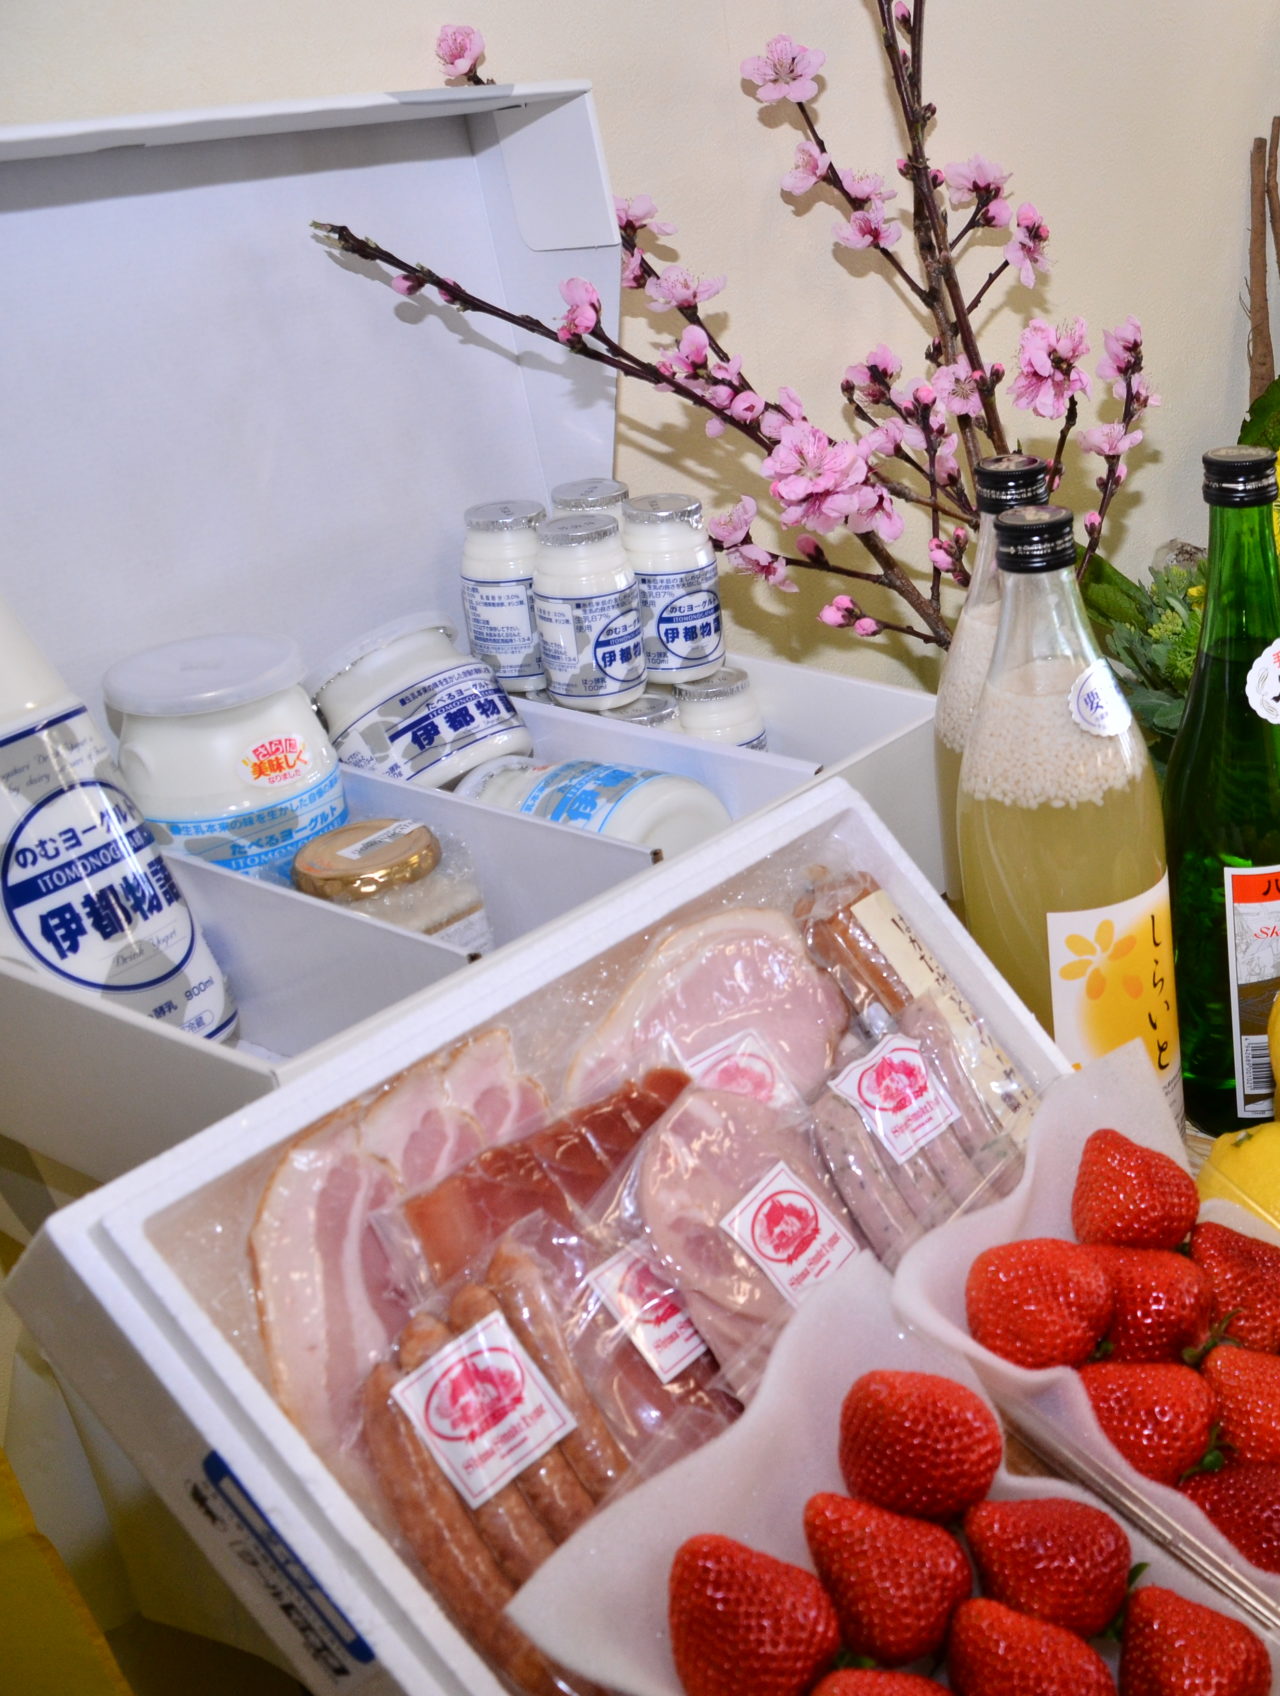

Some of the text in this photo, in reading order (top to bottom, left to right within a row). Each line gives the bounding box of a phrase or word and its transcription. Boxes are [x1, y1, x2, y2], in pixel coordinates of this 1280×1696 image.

[251, 750, 308, 780] 美味しく
[184, 976, 214, 1001] 900ml
[1148, 914, 1171, 1071] しらいと
